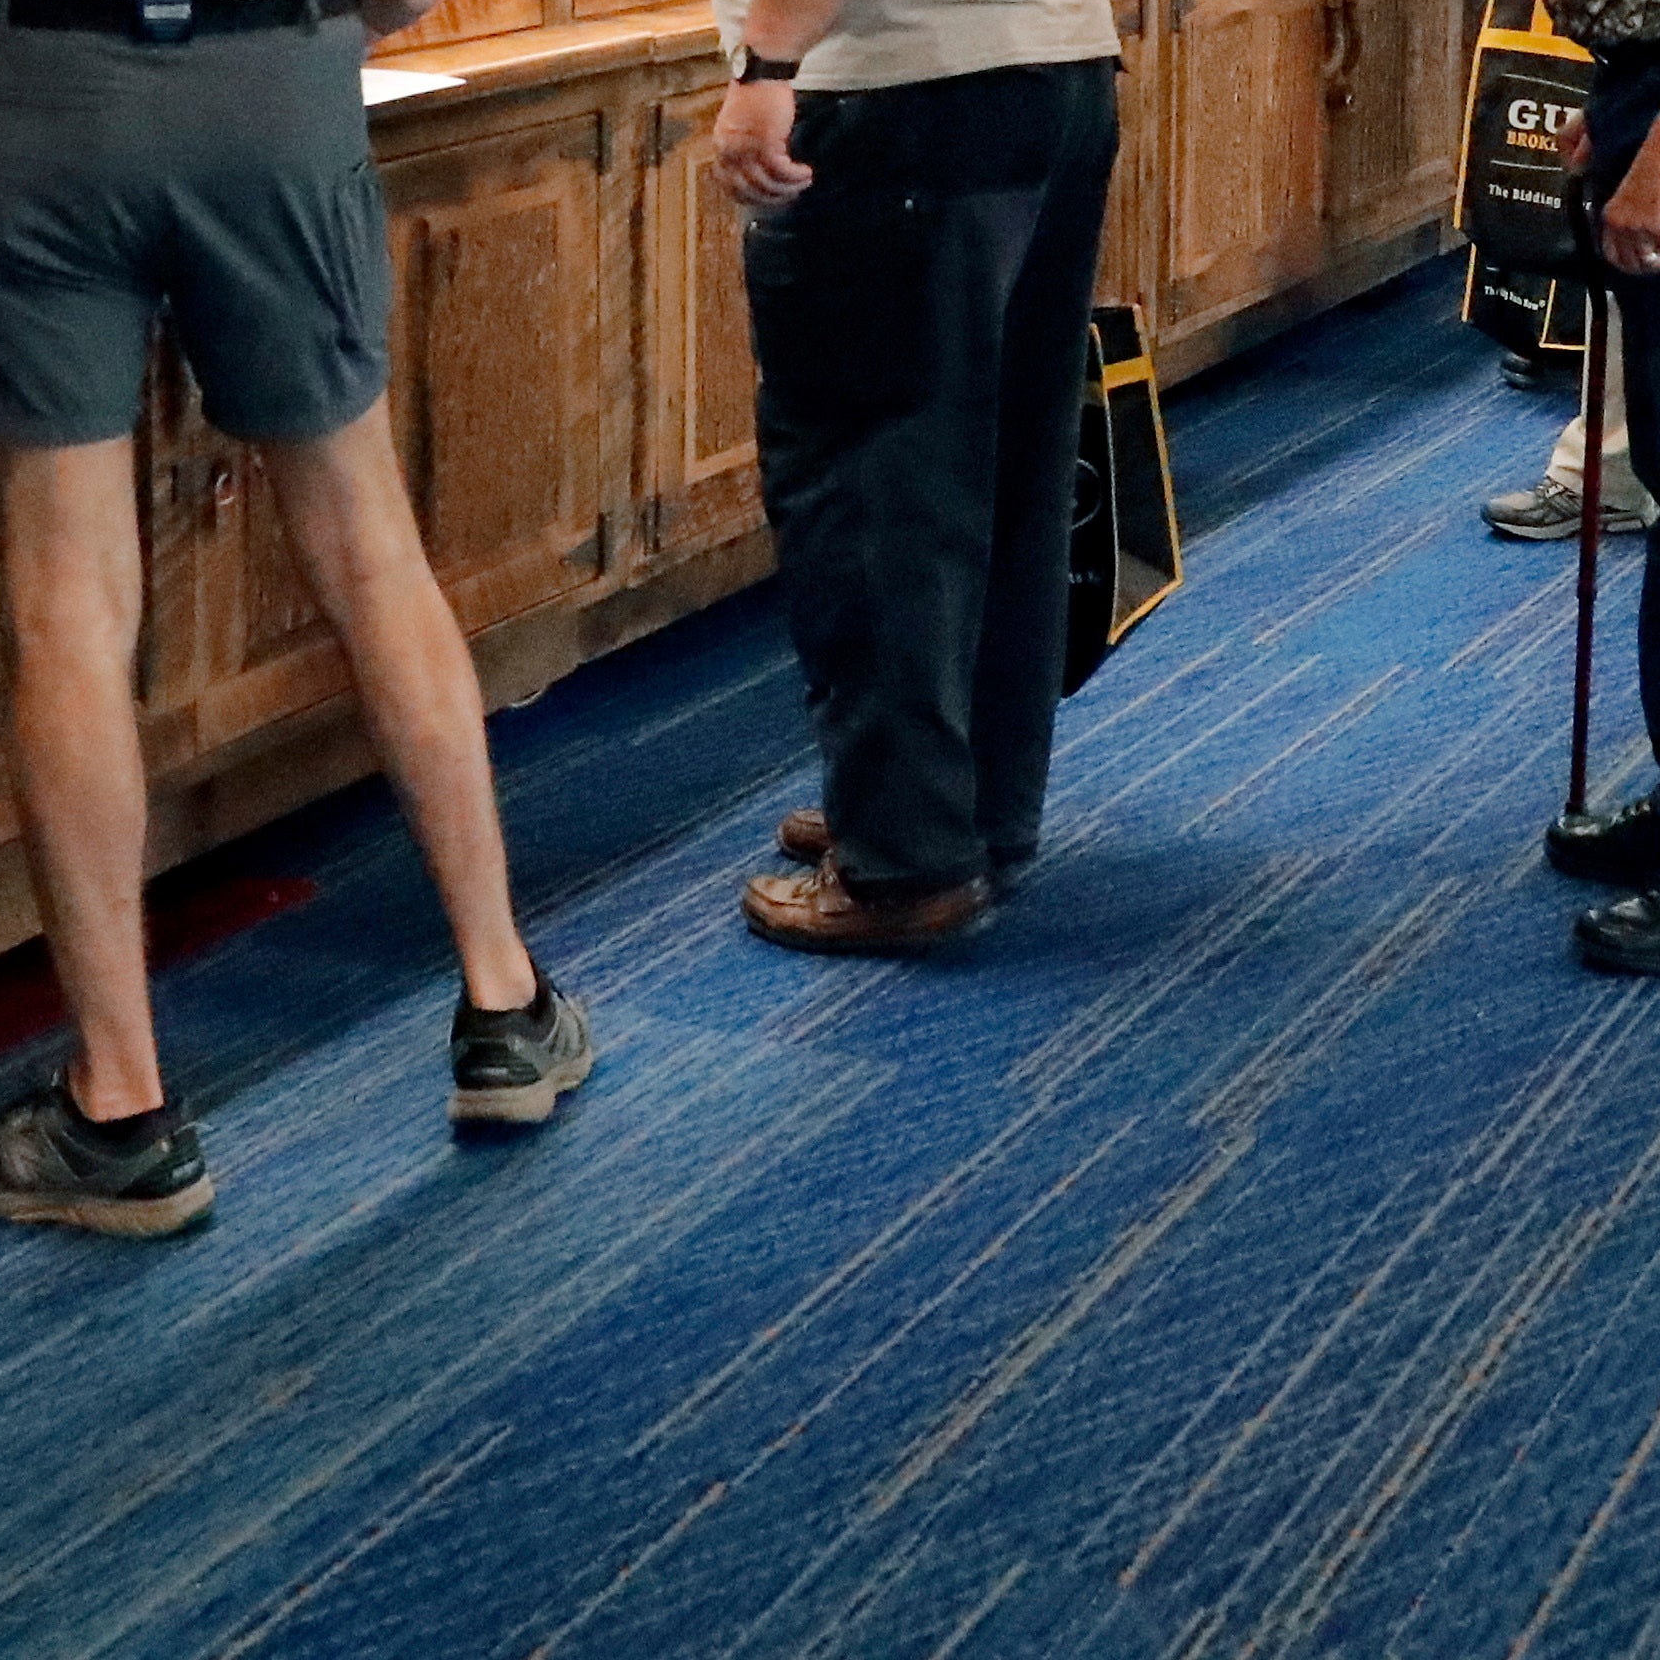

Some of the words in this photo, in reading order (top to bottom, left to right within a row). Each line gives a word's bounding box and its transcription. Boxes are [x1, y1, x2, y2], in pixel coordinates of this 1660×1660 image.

[1507, 98, 1583, 135] GU
[1489, 183, 1509, 199] The
[1512, 187, 1562, 210] Bidding
